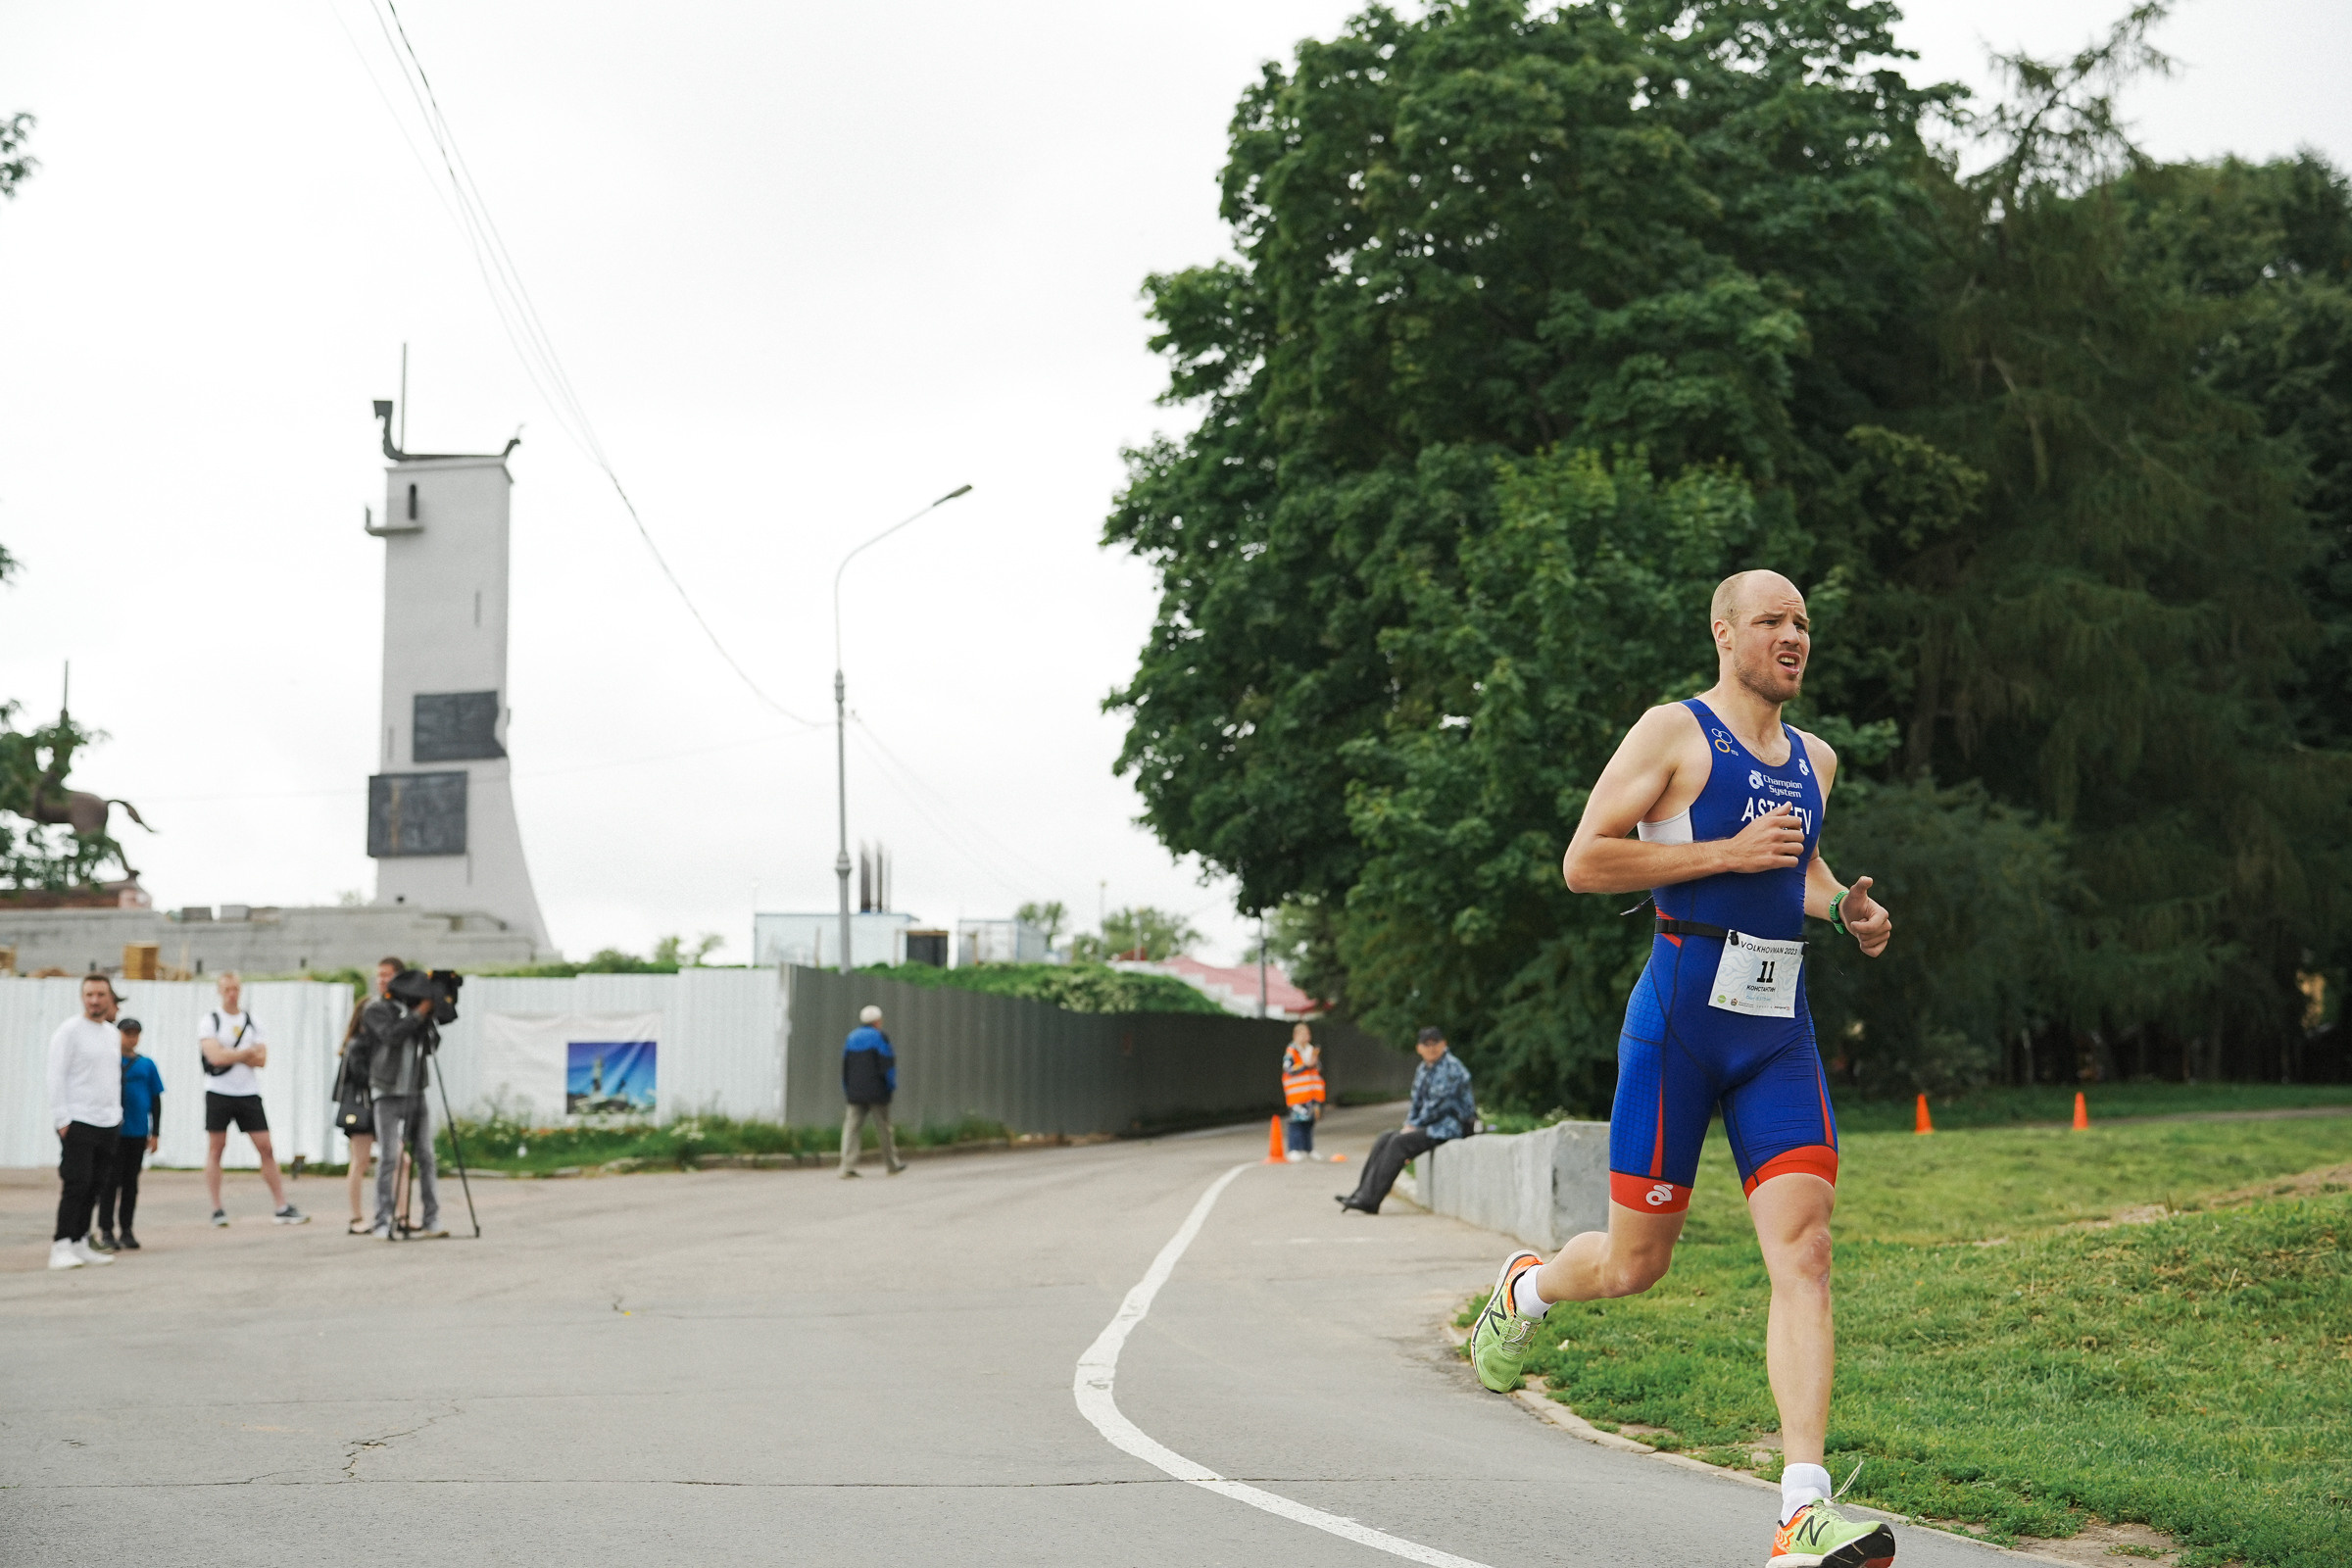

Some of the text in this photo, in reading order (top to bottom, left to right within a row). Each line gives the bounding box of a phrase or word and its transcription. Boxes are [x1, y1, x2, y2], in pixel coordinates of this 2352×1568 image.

[1763, 775, 1803, 789] Champion
[1769, 785, 1802, 798] System
[1756, 960, 1775, 983] 11
